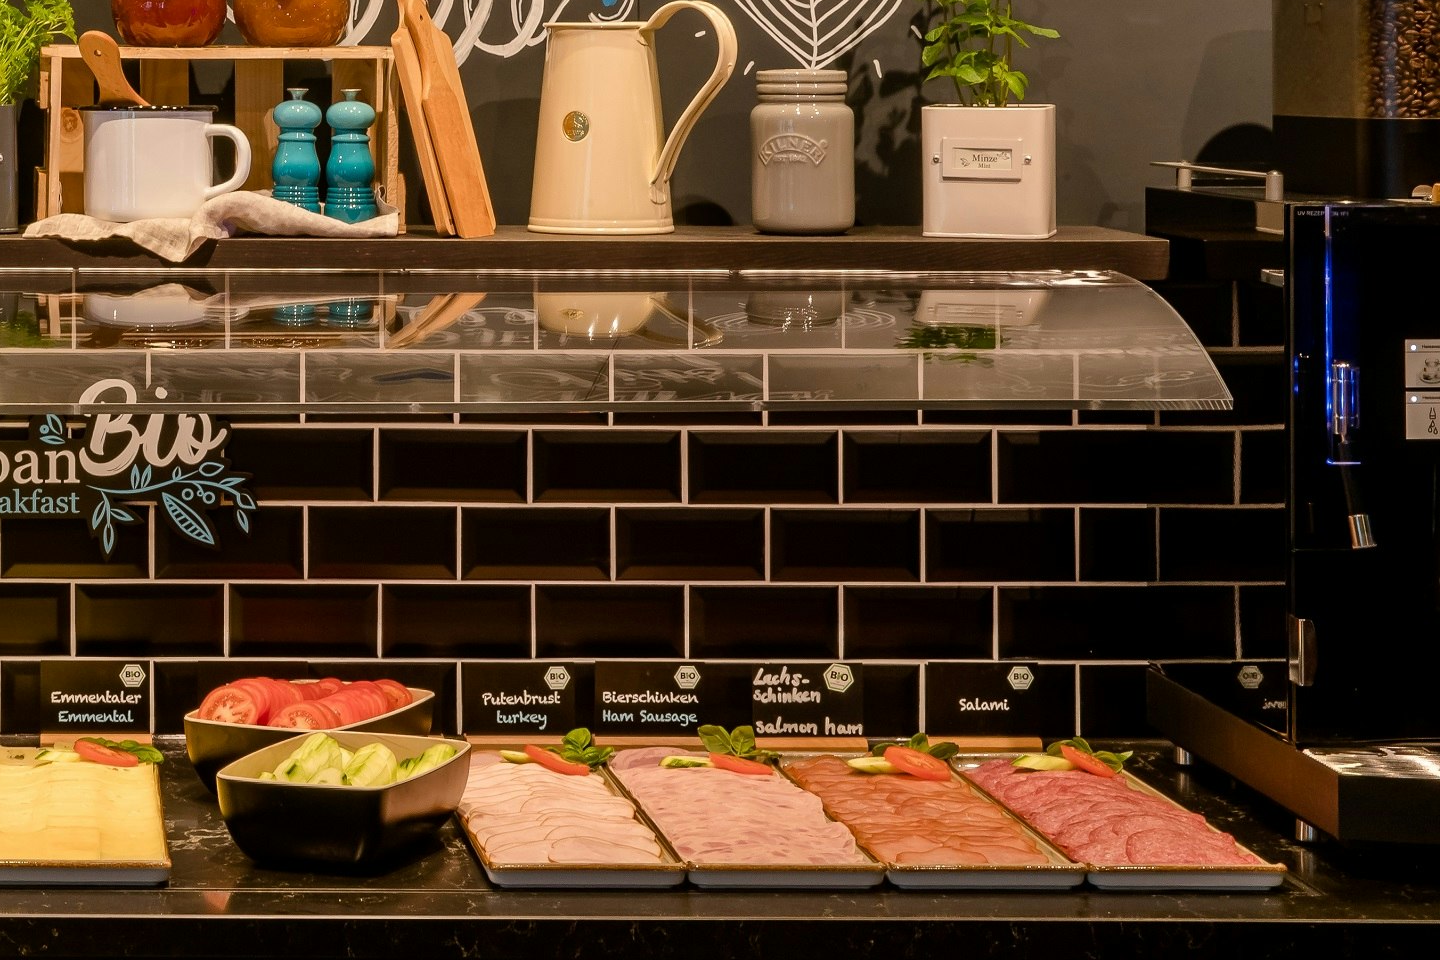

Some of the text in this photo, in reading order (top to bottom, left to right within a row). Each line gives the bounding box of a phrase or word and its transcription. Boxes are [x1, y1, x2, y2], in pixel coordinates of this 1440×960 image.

[761, 136, 822, 160] KILNER
[972, 154, 998, 163] Minze
[78, 378, 228, 477] Bio
[50, 691, 142, 705] Emmentaler
[481, 690, 561, 706] Putenbrust
[602, 691, 699, 705] Bierschinken
[959, 698, 1011, 712] Salami
[58, 709, 135, 724] Emmental
[496, 709, 548, 731] turkey
[602, 709, 699, 727] Ham Sausage
[824, 716, 864, 735] ham
